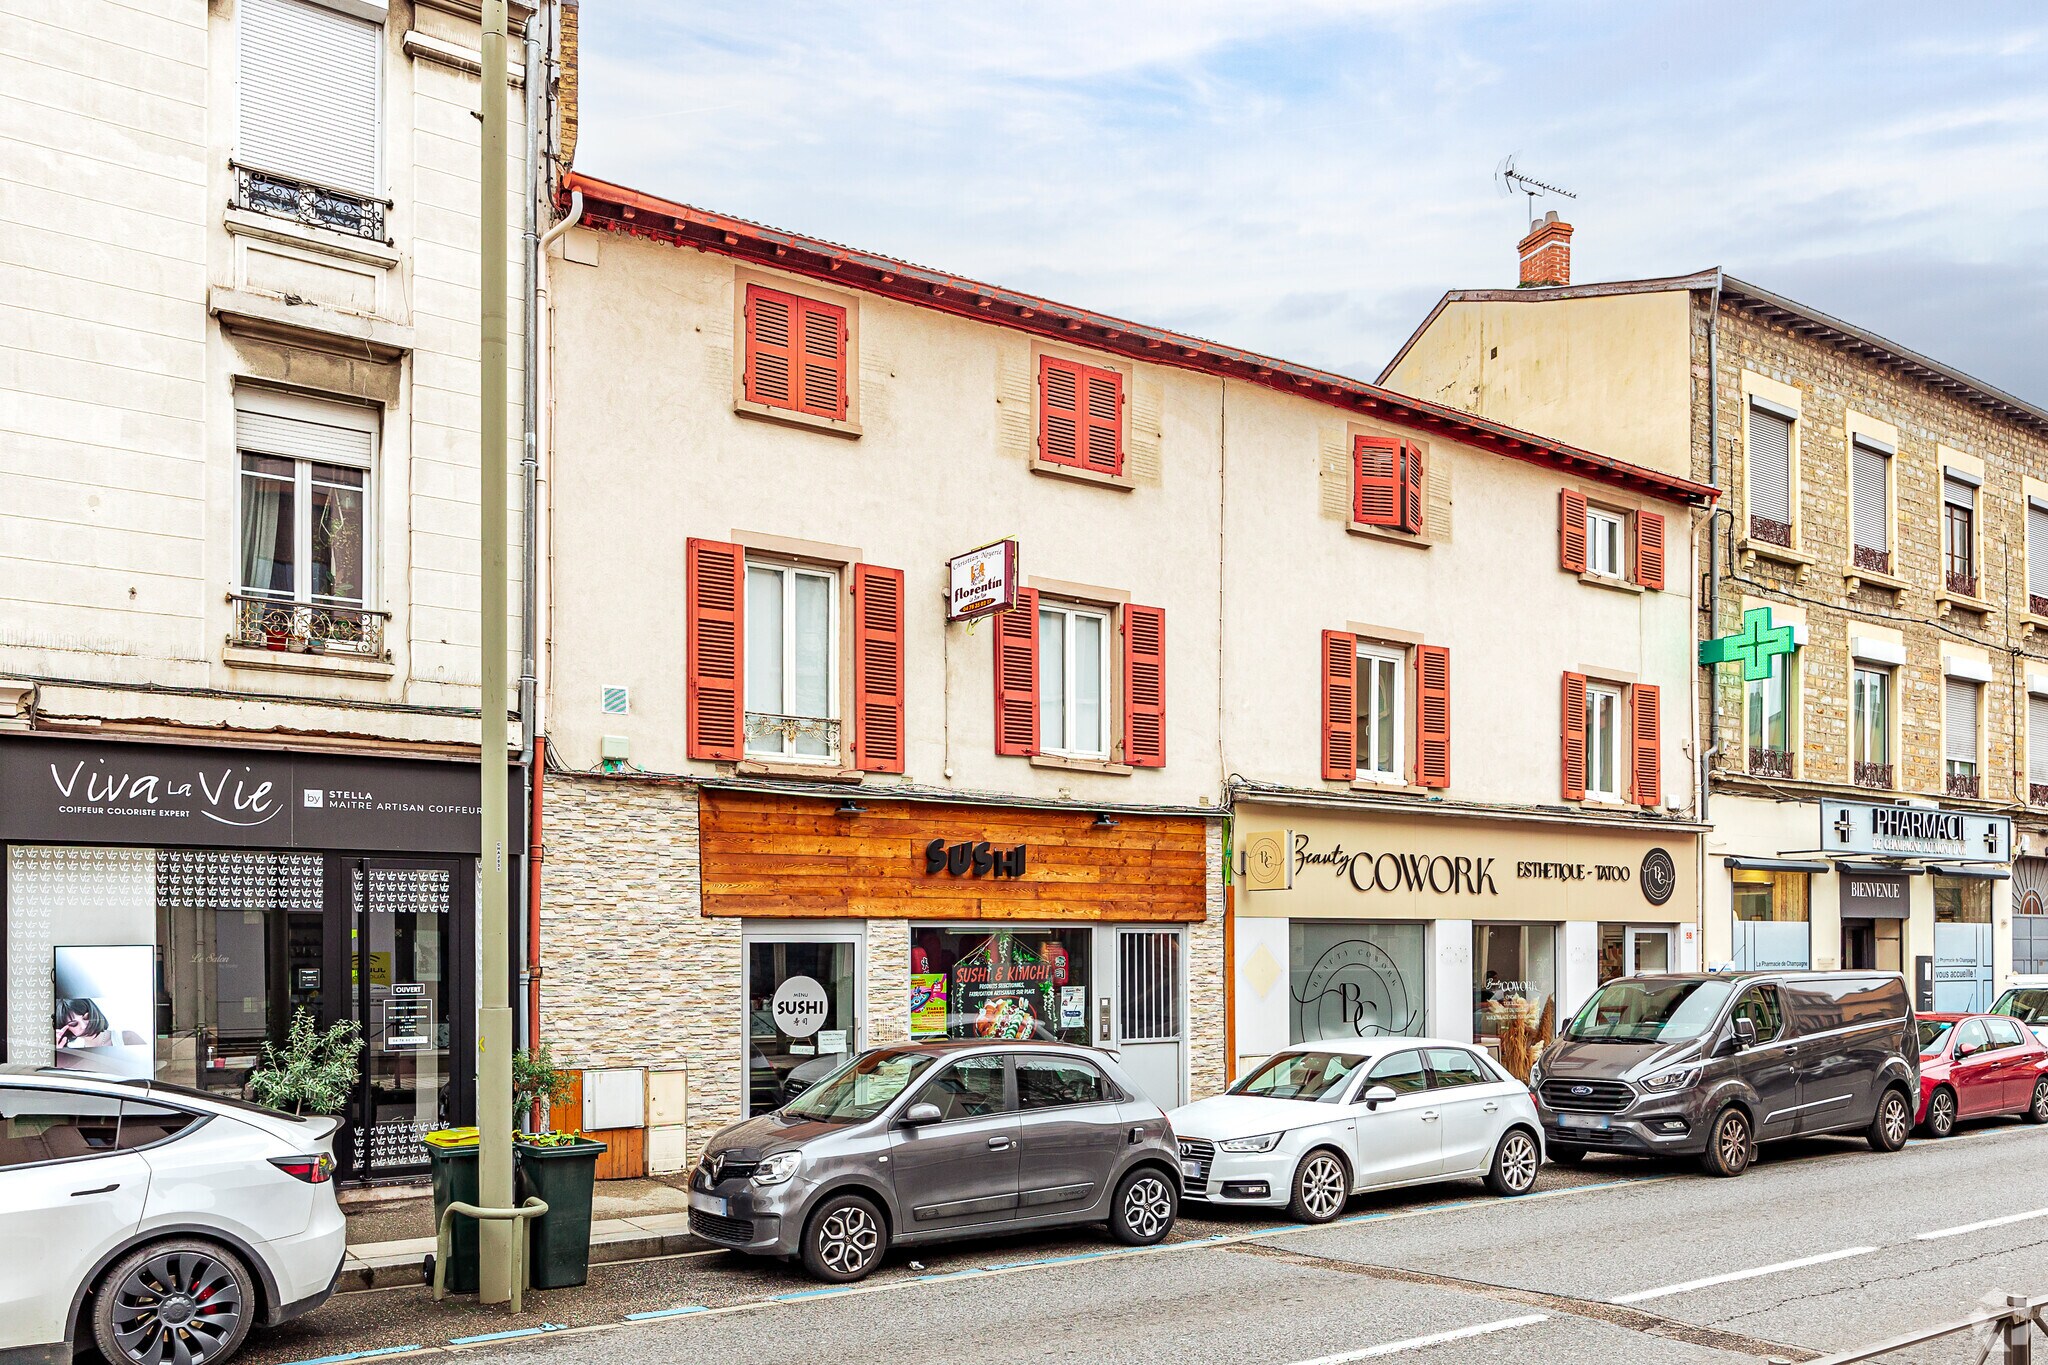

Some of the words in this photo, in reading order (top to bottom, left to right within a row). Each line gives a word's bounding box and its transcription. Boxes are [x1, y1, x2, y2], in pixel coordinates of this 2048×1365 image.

[953, 555, 978, 570] Christian
[51, 758, 159, 804] Viva
[198, 766, 273, 812] Vie
[307, 793, 320, 804] by
[329, 790, 373, 800] STELLA
[58, 805, 104, 815] COIFFEUR
[107, 807, 156, 816] COLORISTE
[159, 809, 190, 818] EXPERT
[329, 801, 372, 810] MAITRE
[376, 803, 424, 812] ARTISAN
[428, 805, 482, 815] COIFFEUR
[1873, 838, 1883, 849] DE
[1884, 839, 1922, 852] CHAMPAGNE
[1923, 842, 1933, 853] AU
[926, 838, 1026, 877] SUSHI
[1295, 833, 1352, 877] Beauty
[1350, 851, 1498, 895] COWORK
[1517, 861, 1585, 882] ESTHETIQUE
[1595, 865, 1630, 882] TATOO
[1851, 881, 1900, 898] BIENVENUE
[205, 952, 230, 963] Salon
[1786, 959, 1808, 968] Champagne
[956, 966, 991, 983] SUSHI
[994, 966, 1004, 981] &
[1007, 964, 1050, 981] KIMCHI
[1936, 970, 1949, 978] vous
[1950, 968, 1973, 978] accueille
[1501, 980, 1540, 992] COWORK
[777, 1000, 823, 1015] SUSHI
